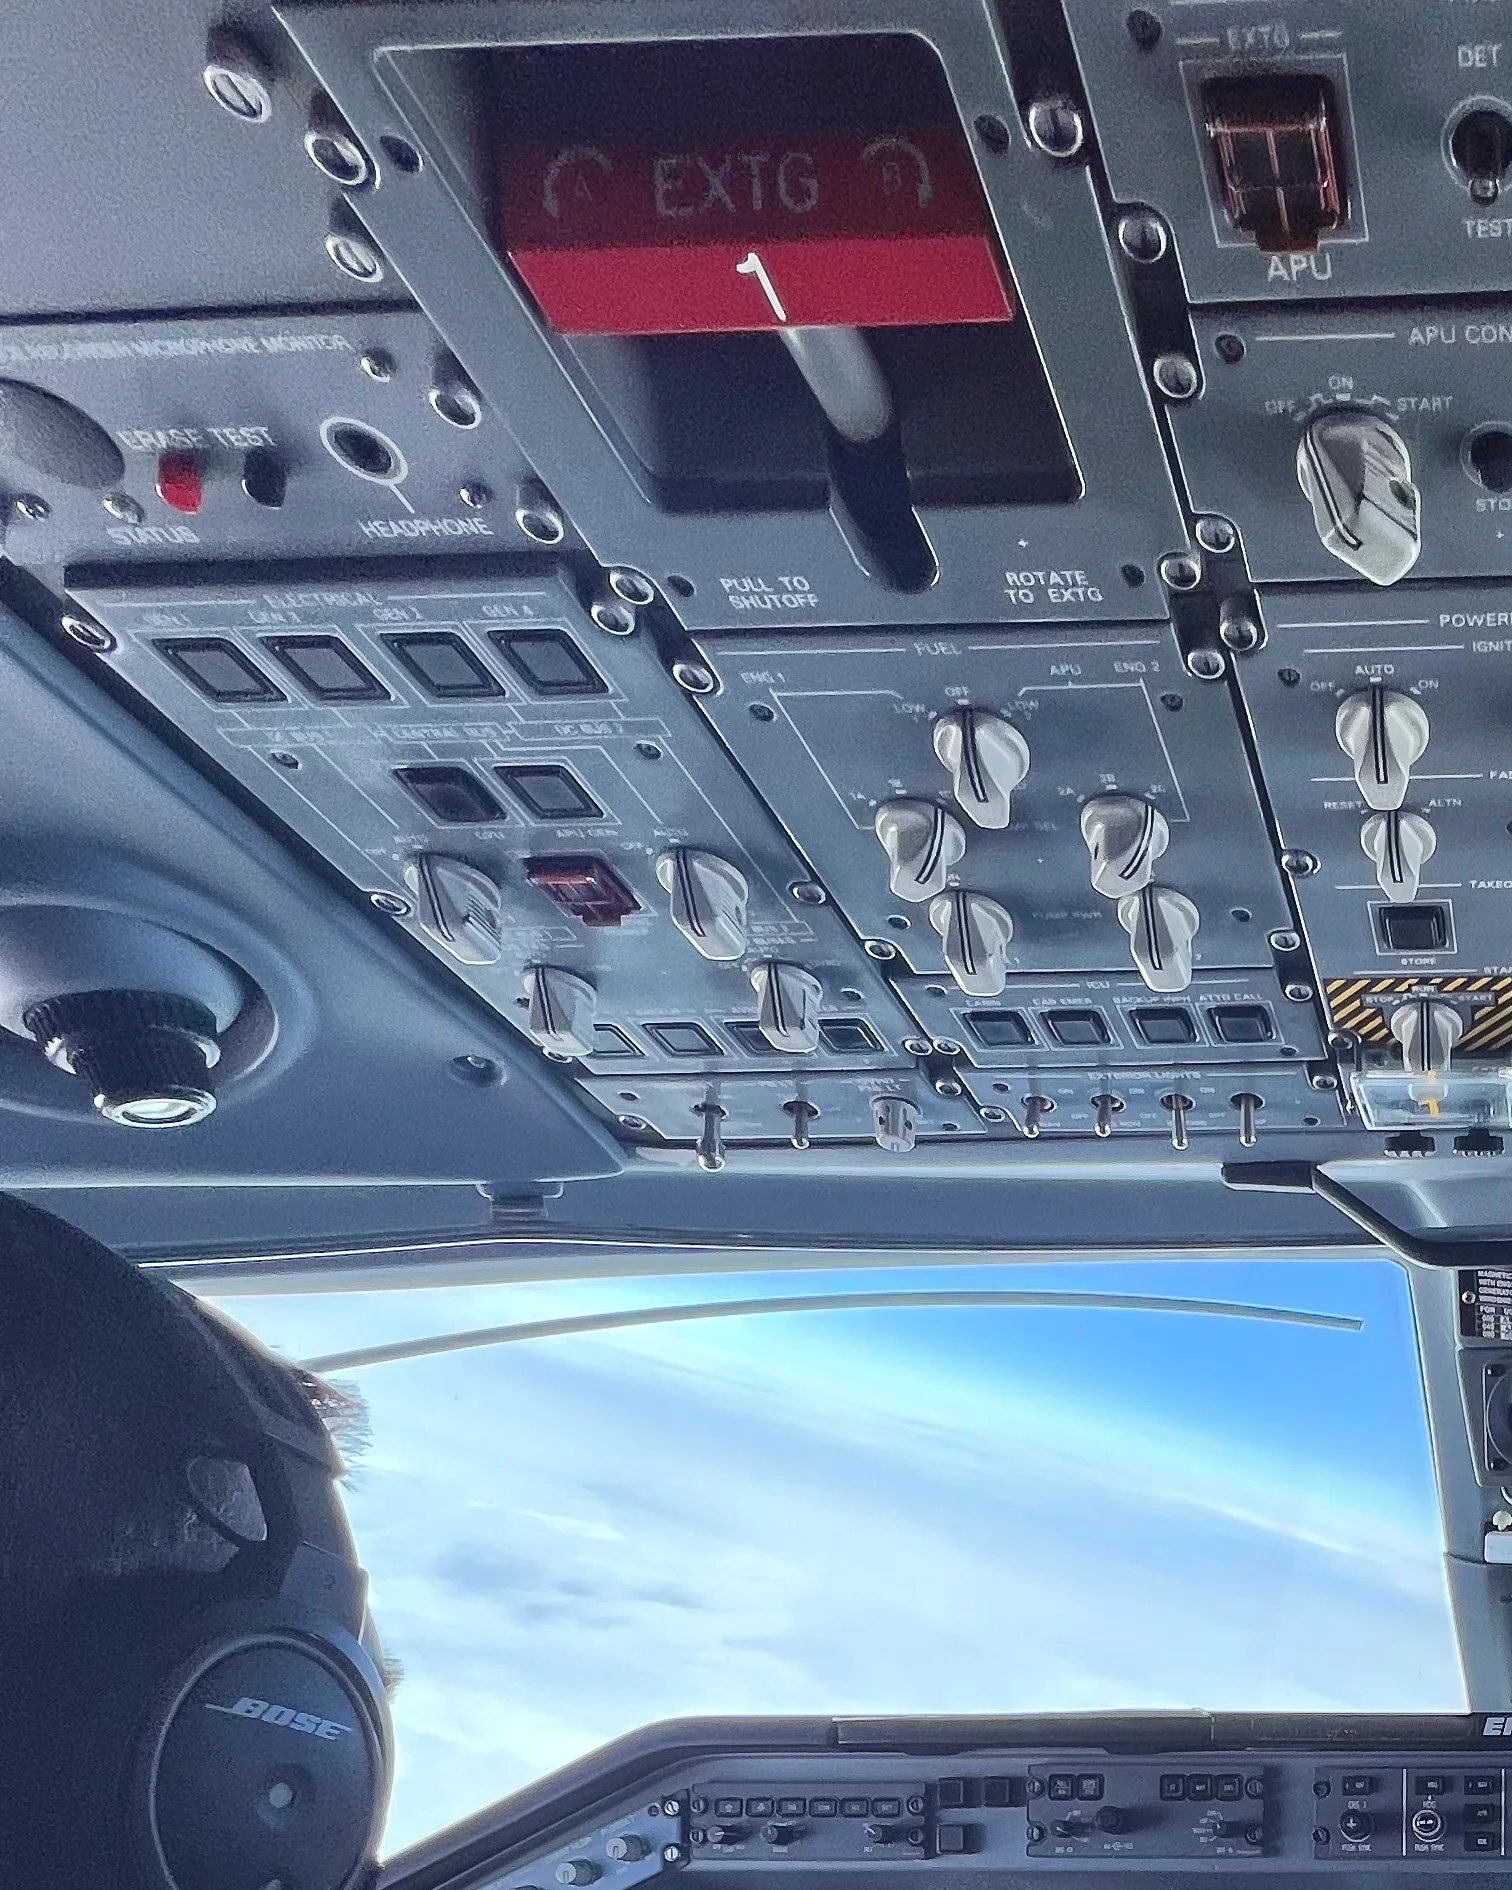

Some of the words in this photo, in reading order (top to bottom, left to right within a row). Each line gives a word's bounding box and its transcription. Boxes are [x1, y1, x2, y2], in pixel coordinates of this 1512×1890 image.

[1458, 46, 1499, 68] DET
[654, 151, 821, 217] EXTG
[1266, 254, 1334, 283] APU
[736, 252, 788, 322] 1
[1408, 325, 1460, 346] APU
[1327, 374, 1354, 392] ON
[1397, 396, 1454, 413] START
[116, 428, 209, 450] ERASE
[208, 426, 277, 449] TEST
[107, 526, 200, 544] STATUS
[361, 517, 495, 540] HEADPHONE
[720, 577, 774, 593] PULL
[779, 575, 810, 591] TO
[1003, 570, 1089, 587] ROTATE
[728, 592, 819, 611] SHUTOFF
[1003, 587, 1035, 604] TO
[1046, 585, 1105, 603] EXTG
[914, 642, 964, 657] FUEL
[1050, 664, 1082, 677] APU
[1113, 661, 1147, 674] ENG
[1354, 663, 1395, 677] AUTO
[740, 671, 775, 685] ENG
[1309, 680, 1337, 692] OFF
[1418, 679, 1440, 691] ON
[944, 685, 972, 698] OFF
[1322, 799, 1363, 812] RESET
[1428, 797, 1462, 809] ALTN
[1400, 956, 1438, 967] STORE
[1411, 985, 1436, 994] RUN
[1365, 996, 1395, 1005] STOP
[1457, 994, 1496, 1004] START
[204, 1697, 354, 1741] BOSE
